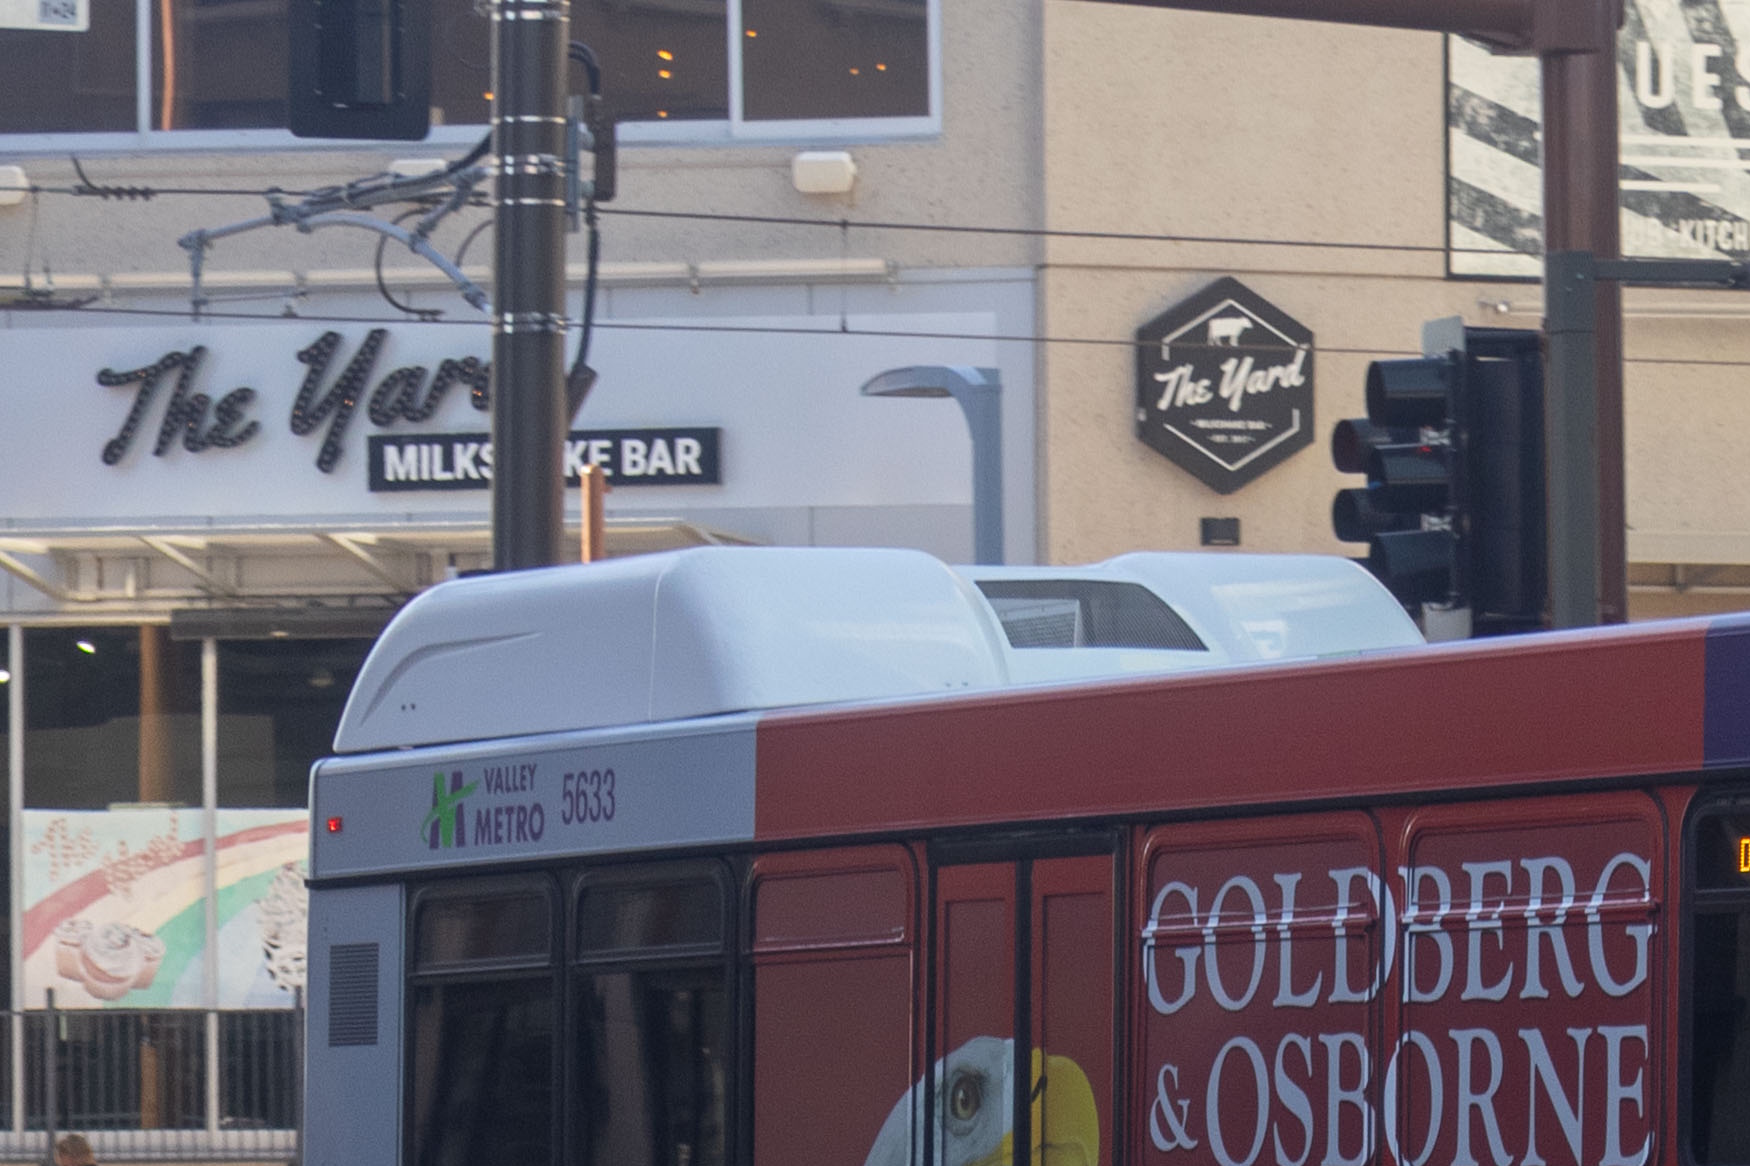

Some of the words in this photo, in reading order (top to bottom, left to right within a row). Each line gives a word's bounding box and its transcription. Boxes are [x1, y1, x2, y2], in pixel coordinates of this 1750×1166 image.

[97, 345, 260, 466] The
[1154, 363, 1213, 411] The
[1219, 348, 1305, 413] Yard
[621, 437, 702, 476] BAR
[484, 763, 537, 794] VALLEY
[561, 767, 616, 825] 5633
[475, 802, 545, 846] METRO
[1142, 852, 1657, 1015] GOLDBERG
[1149, 1063, 1198, 1152] &
